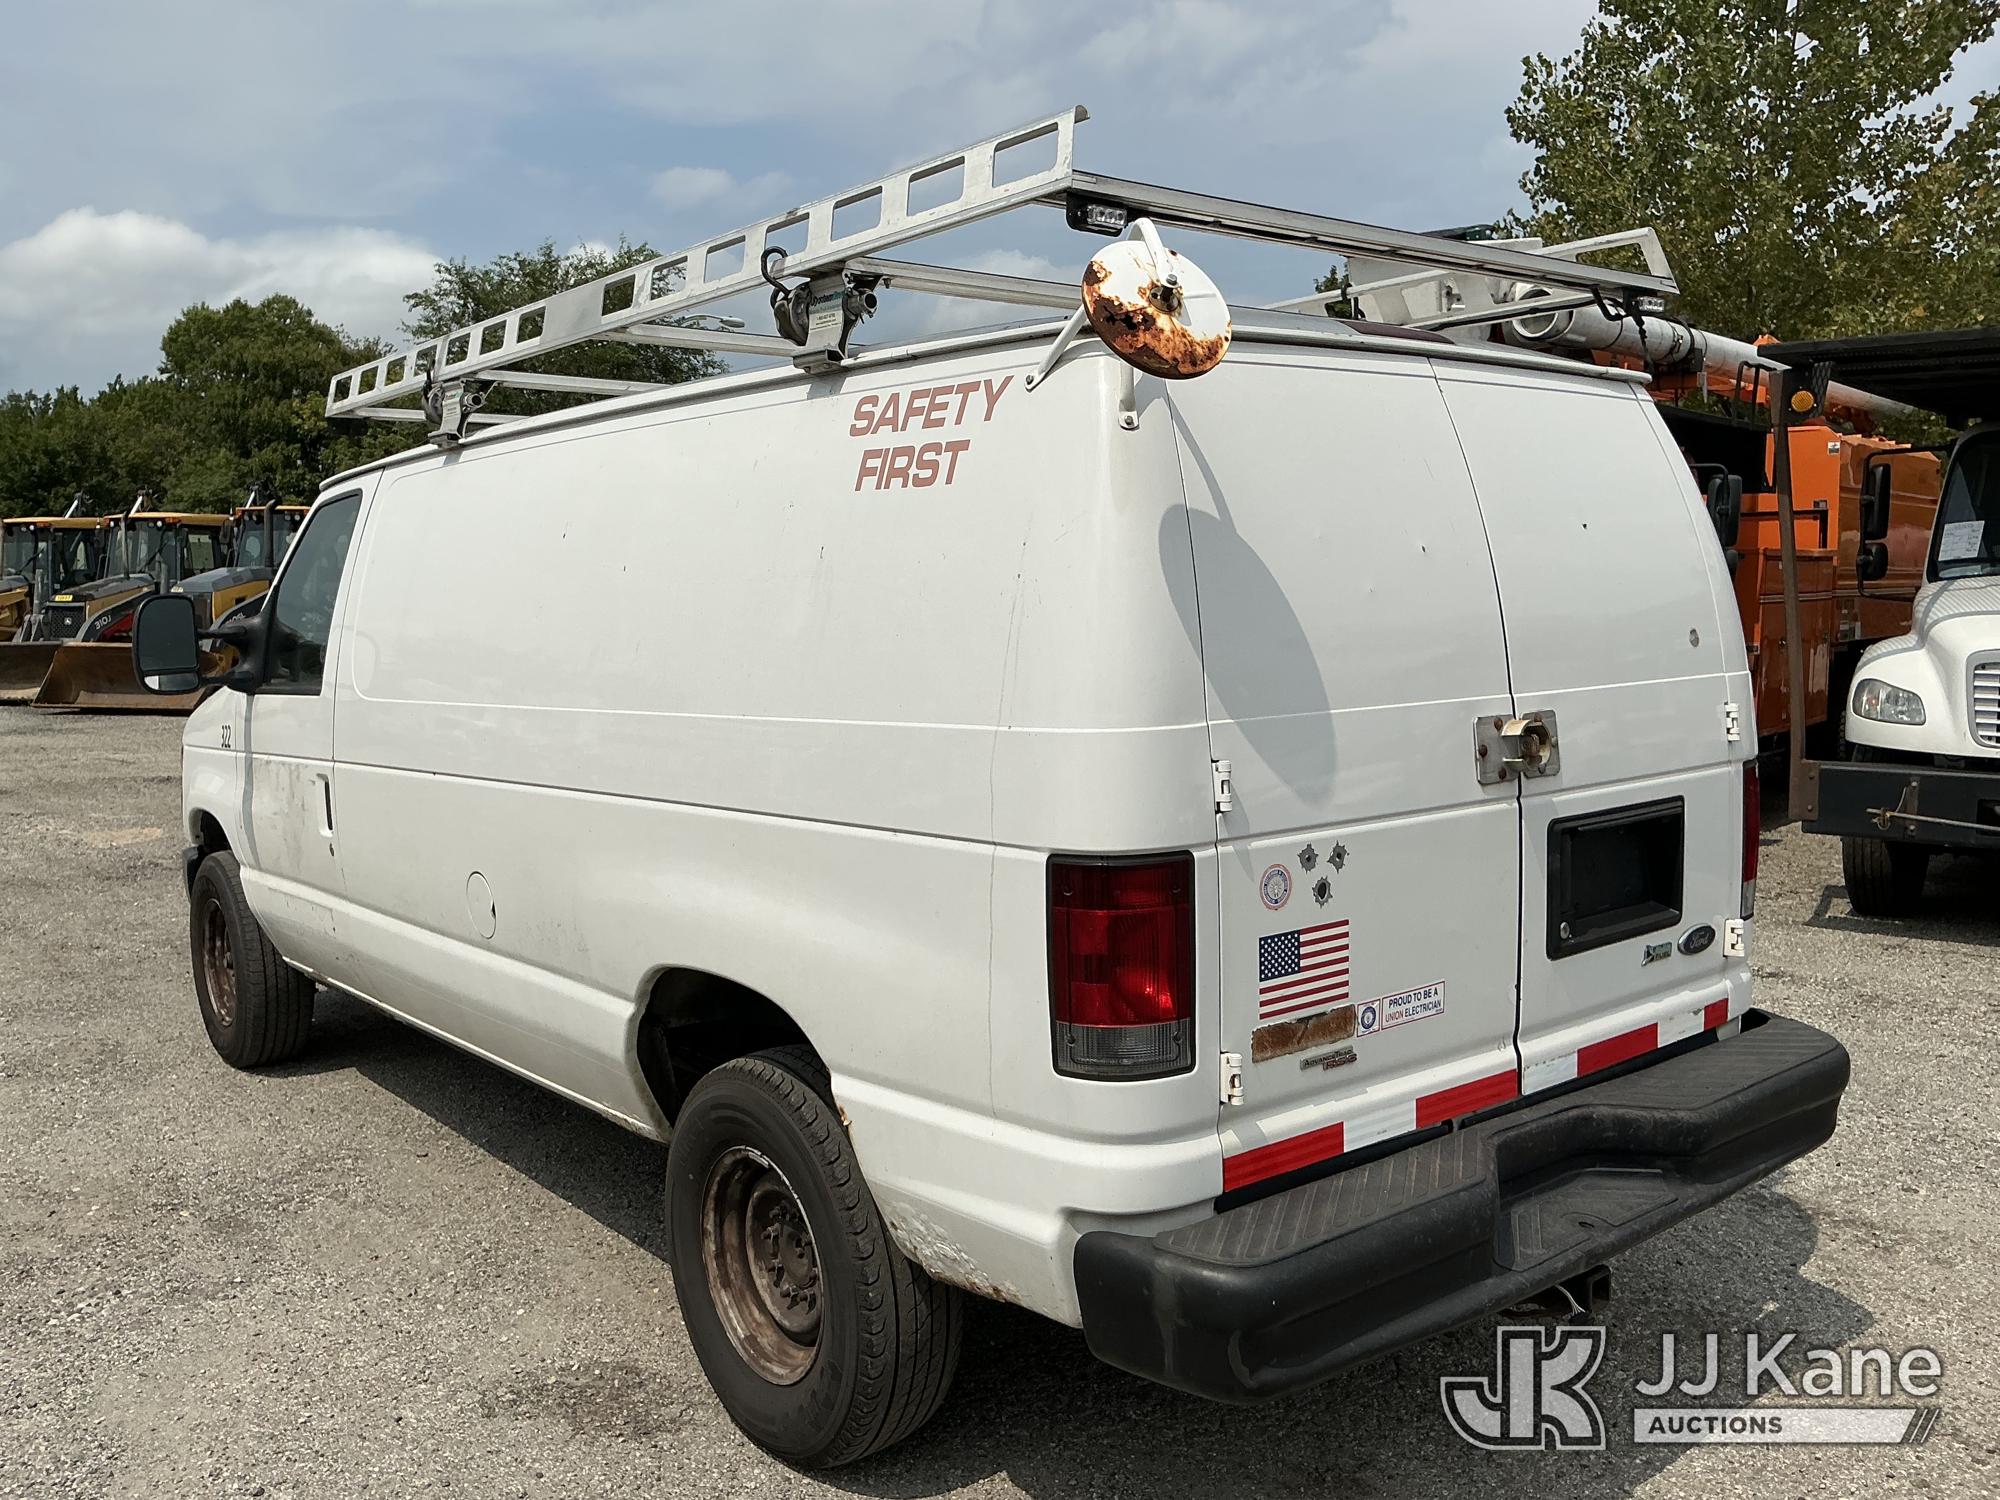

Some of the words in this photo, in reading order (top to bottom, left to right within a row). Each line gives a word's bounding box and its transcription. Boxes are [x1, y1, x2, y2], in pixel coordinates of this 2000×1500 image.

[849, 375, 1015, 437] SAFETY
[854, 439, 971, 491] FIRST
[221, 724, 231, 748] 322
[1388, 993, 1412, 1009] PROUD
[1413, 991, 1422, 1002] TO
[1423, 988, 1432, 999] BE
[1433, 986, 1439, 997] A
[1385, 1008, 1404, 1023] UNION
[1404, 1000, 1441, 1018] ELECTRICIAN
